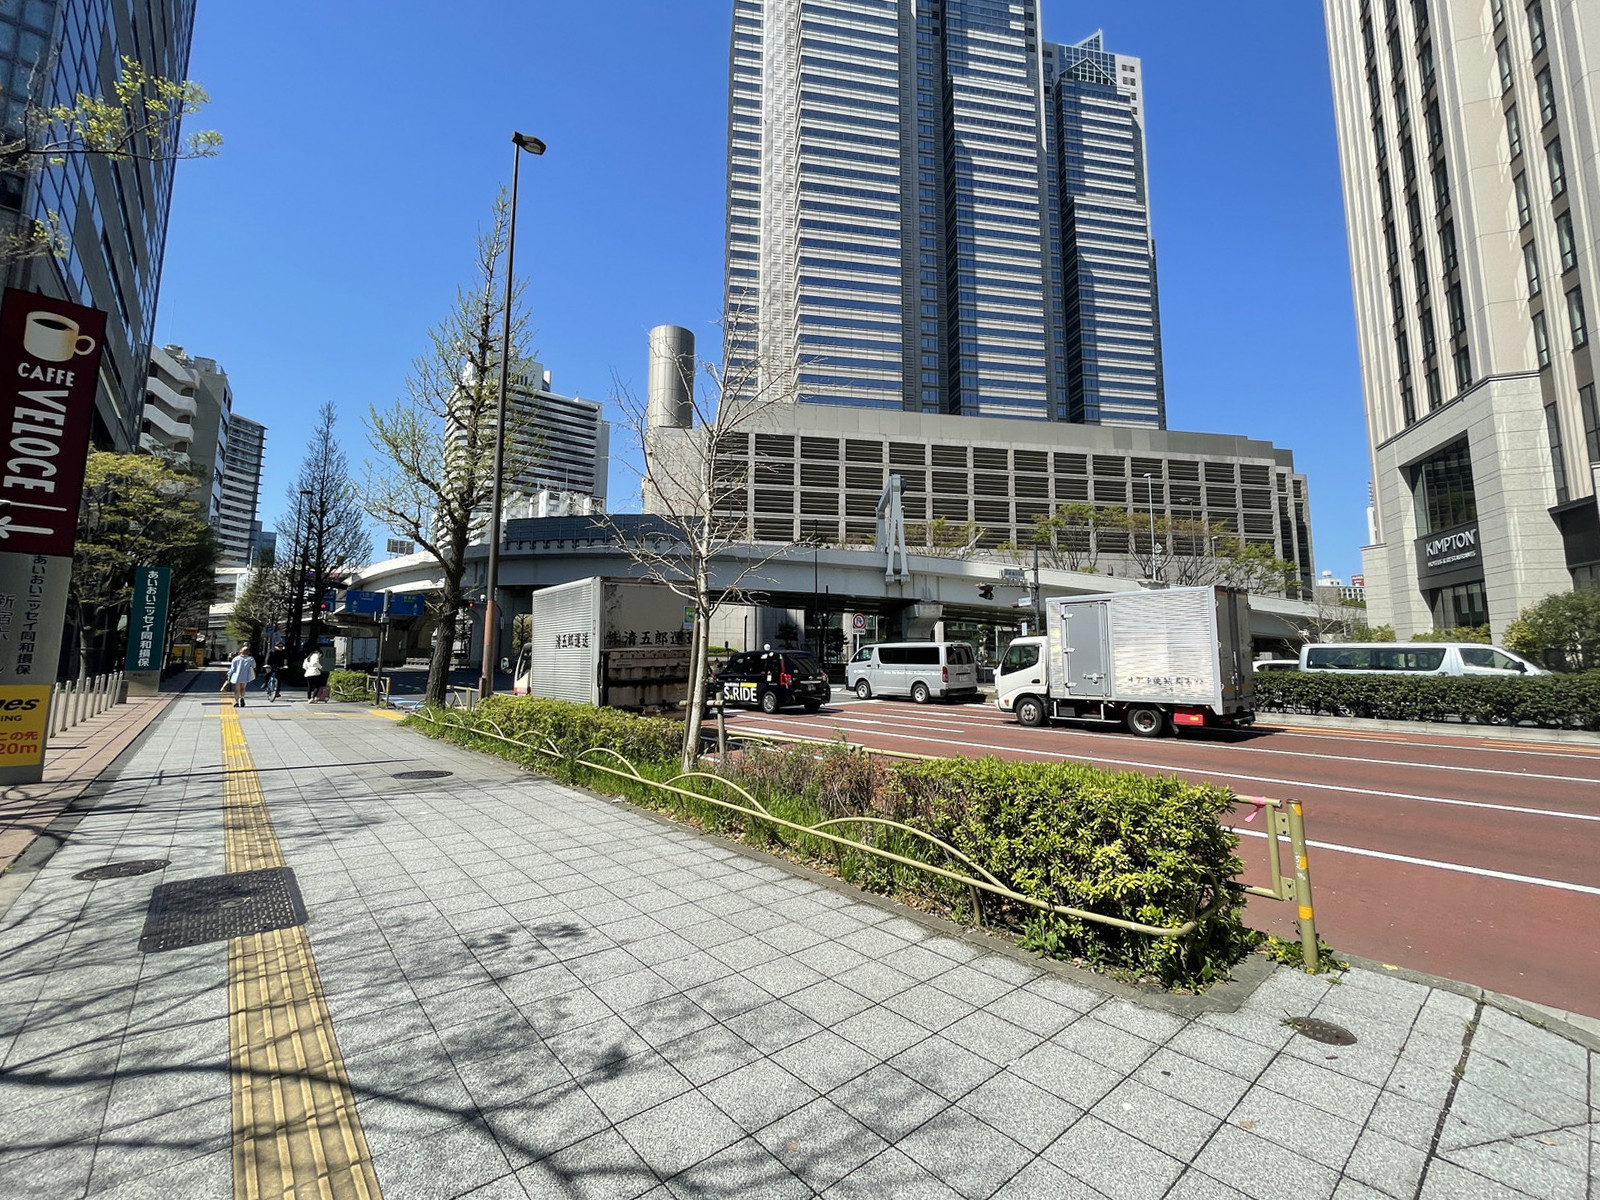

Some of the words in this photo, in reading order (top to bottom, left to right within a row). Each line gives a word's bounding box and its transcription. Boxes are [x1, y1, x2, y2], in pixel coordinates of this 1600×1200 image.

[3, 390, 69, 493] VELOCE
[1426, 529, 1476, 556] KIMPTON
[16, 554, 47, 675] あいおいニッセイ同和損保
[138, 570, 159, 667] あいおいニッセイ同和損保
[724, 686, 758, 702] S.RIDE
